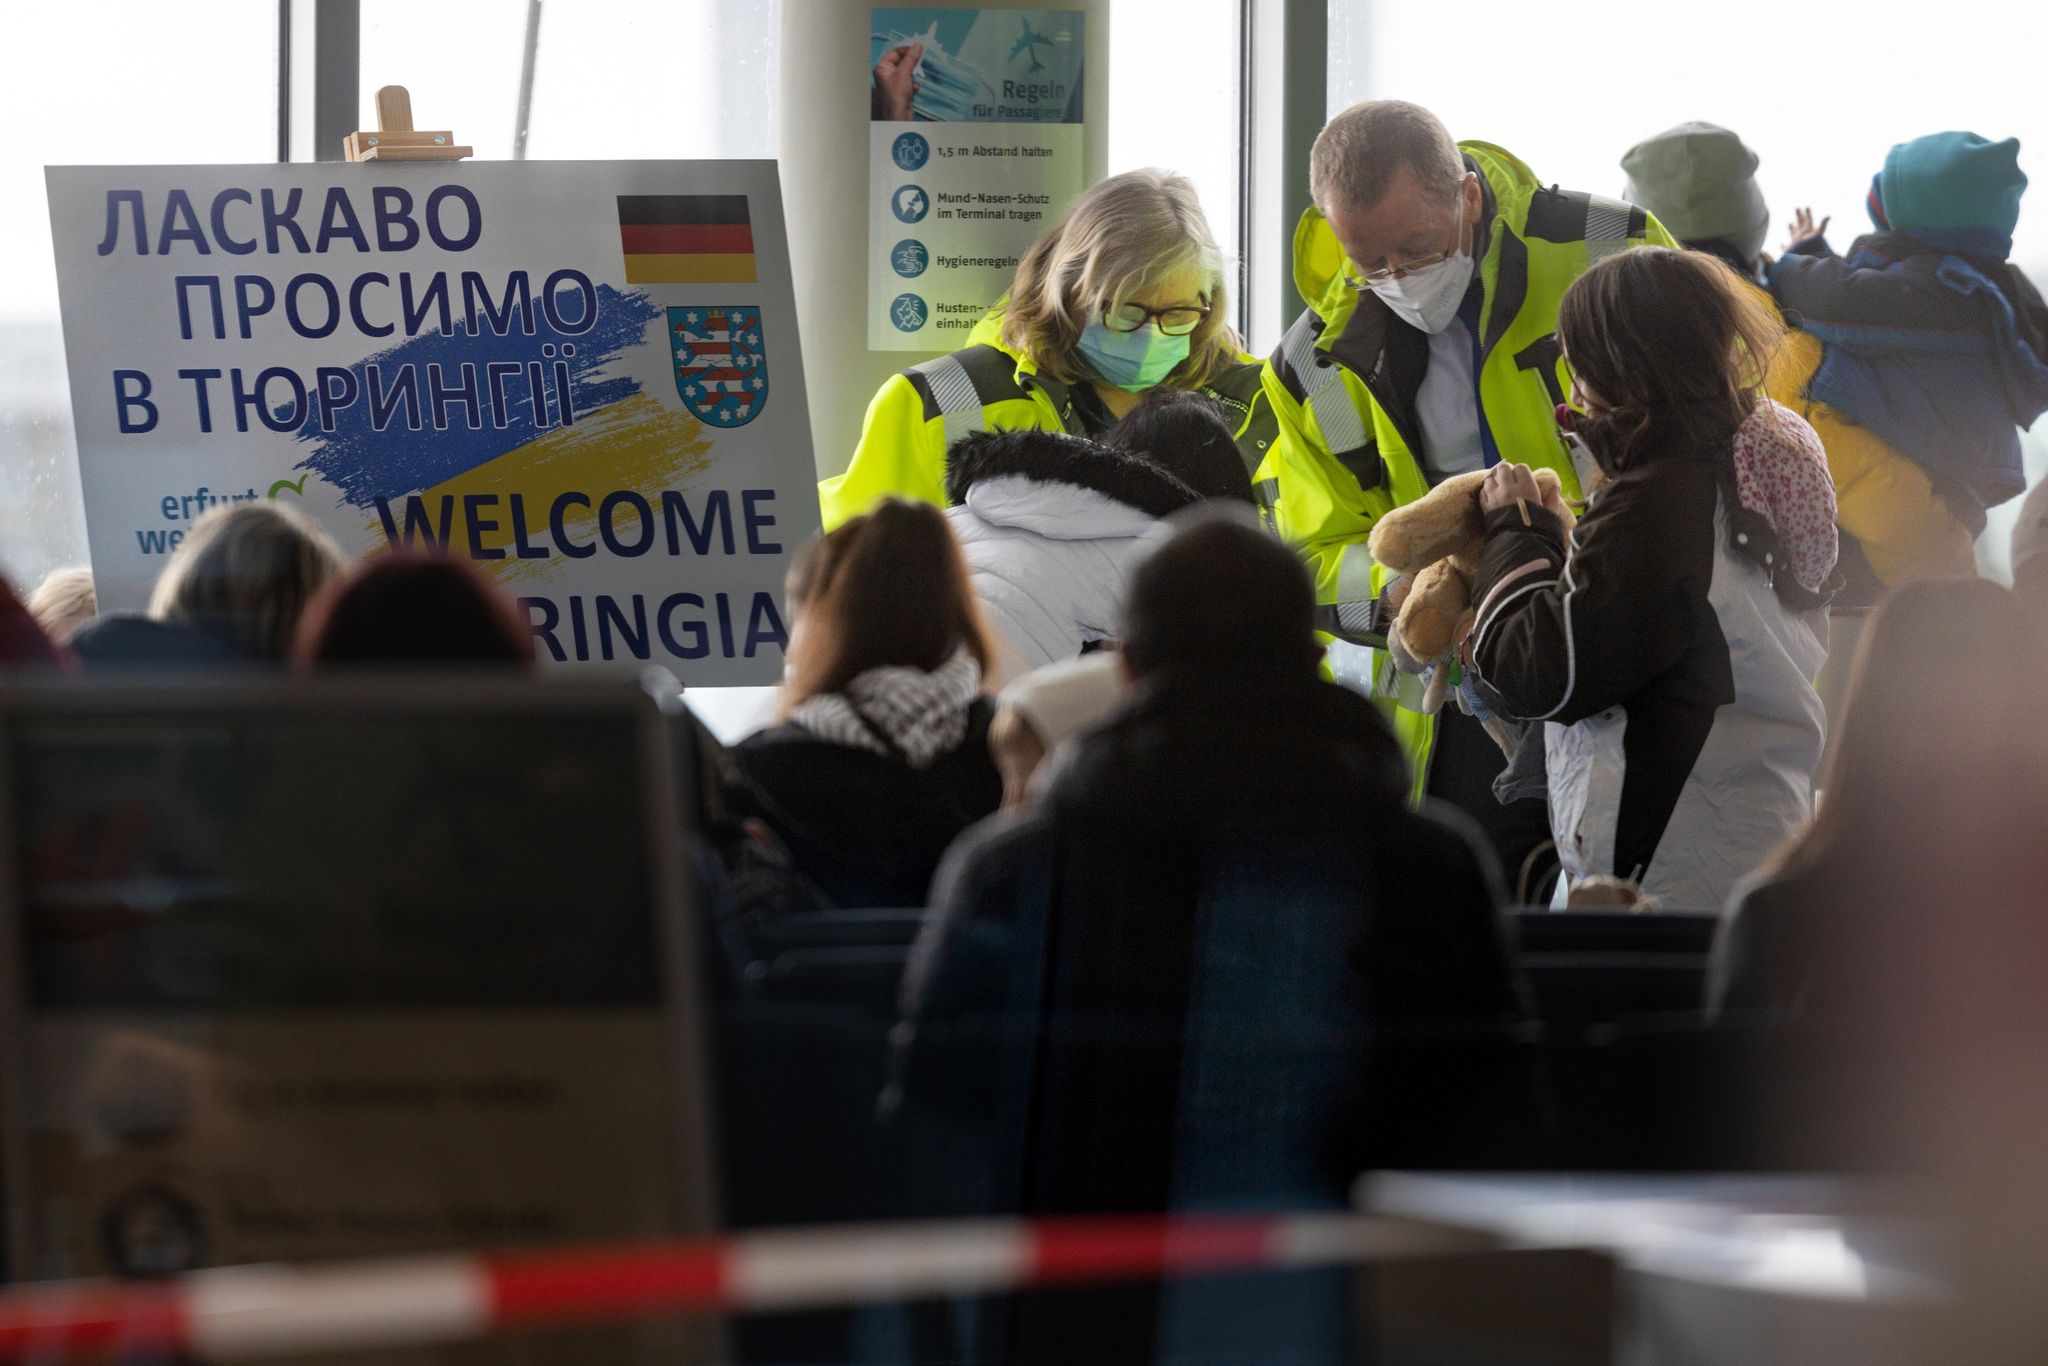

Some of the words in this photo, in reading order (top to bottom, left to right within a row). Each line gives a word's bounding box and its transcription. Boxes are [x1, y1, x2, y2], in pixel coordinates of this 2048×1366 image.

[1003, 80, 1065, 104] Regeln
[972, 104, 993, 118] für
[998, 105, 1062, 121] Passagiere
[938, 147, 954, 158] 1,5
[958, 147, 969, 156] m
[972, 146, 1018, 157] Abstand
[1021, 146, 1053, 157] halten
[938, 193, 1050, 204] Mund-Nasen-Schutz
[97, 184, 482, 256] ЛАСКАВО
[937, 208, 952, 219] im
[956, 208, 1005, 219] Terminal
[1009, 209, 1042, 222] tragen
[937, 255, 1018, 268] Hygieneregeln
[175, 269, 599, 340] ПРОСИМО
[936, 303, 984, 313] Husten-
[936, 317, 978, 329] einhalt
[114, 369, 159, 434] В
[179, 343, 575, 433] ТЮРИНГІЇ
[375, 489, 783, 560] WELCOME
[516, 592, 790, 662] RINGIA
